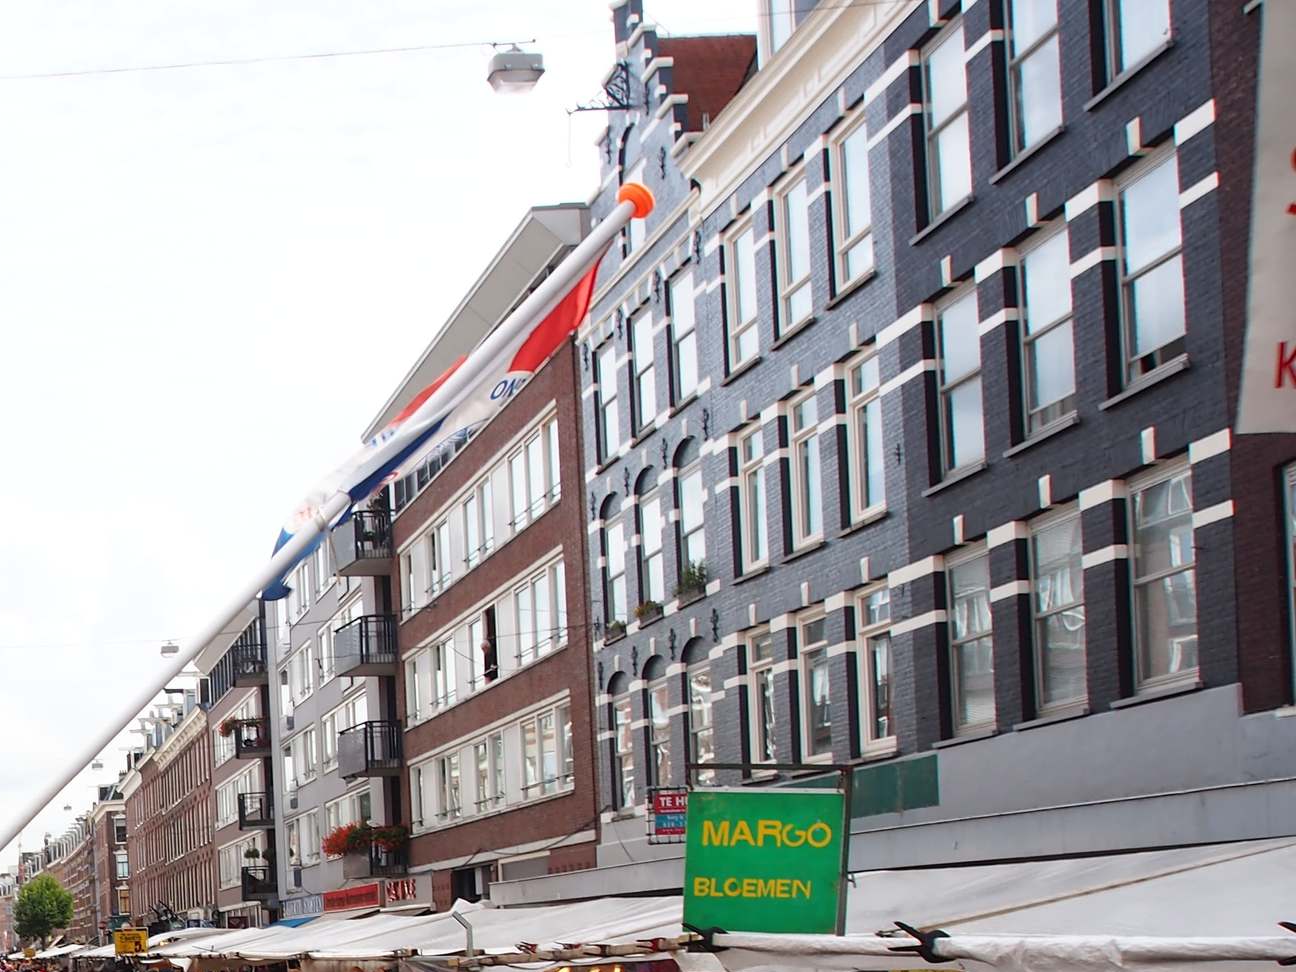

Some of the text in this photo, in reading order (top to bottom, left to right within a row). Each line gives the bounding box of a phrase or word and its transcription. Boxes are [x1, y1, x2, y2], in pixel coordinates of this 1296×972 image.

[658, 796, 673, 807] TE
[702, 819, 833, 848] MARGO
[693, 876, 812, 899] BLOEMEN
